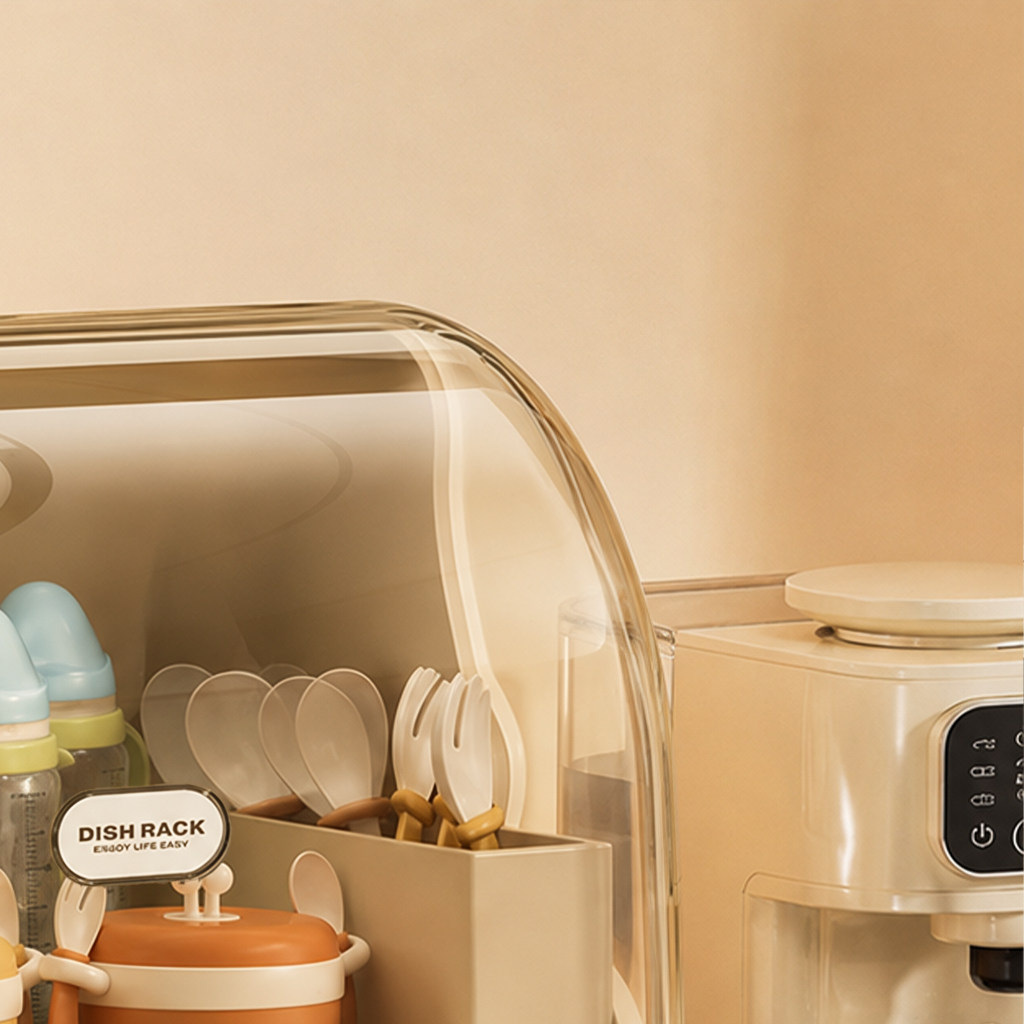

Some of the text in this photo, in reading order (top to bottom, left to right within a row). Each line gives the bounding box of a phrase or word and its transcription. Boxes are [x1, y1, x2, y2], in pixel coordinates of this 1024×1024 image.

[78, 819, 206, 842] DISH RACK
[133, 841, 157, 851] LIFE
[159, 839, 189, 850] EASY
